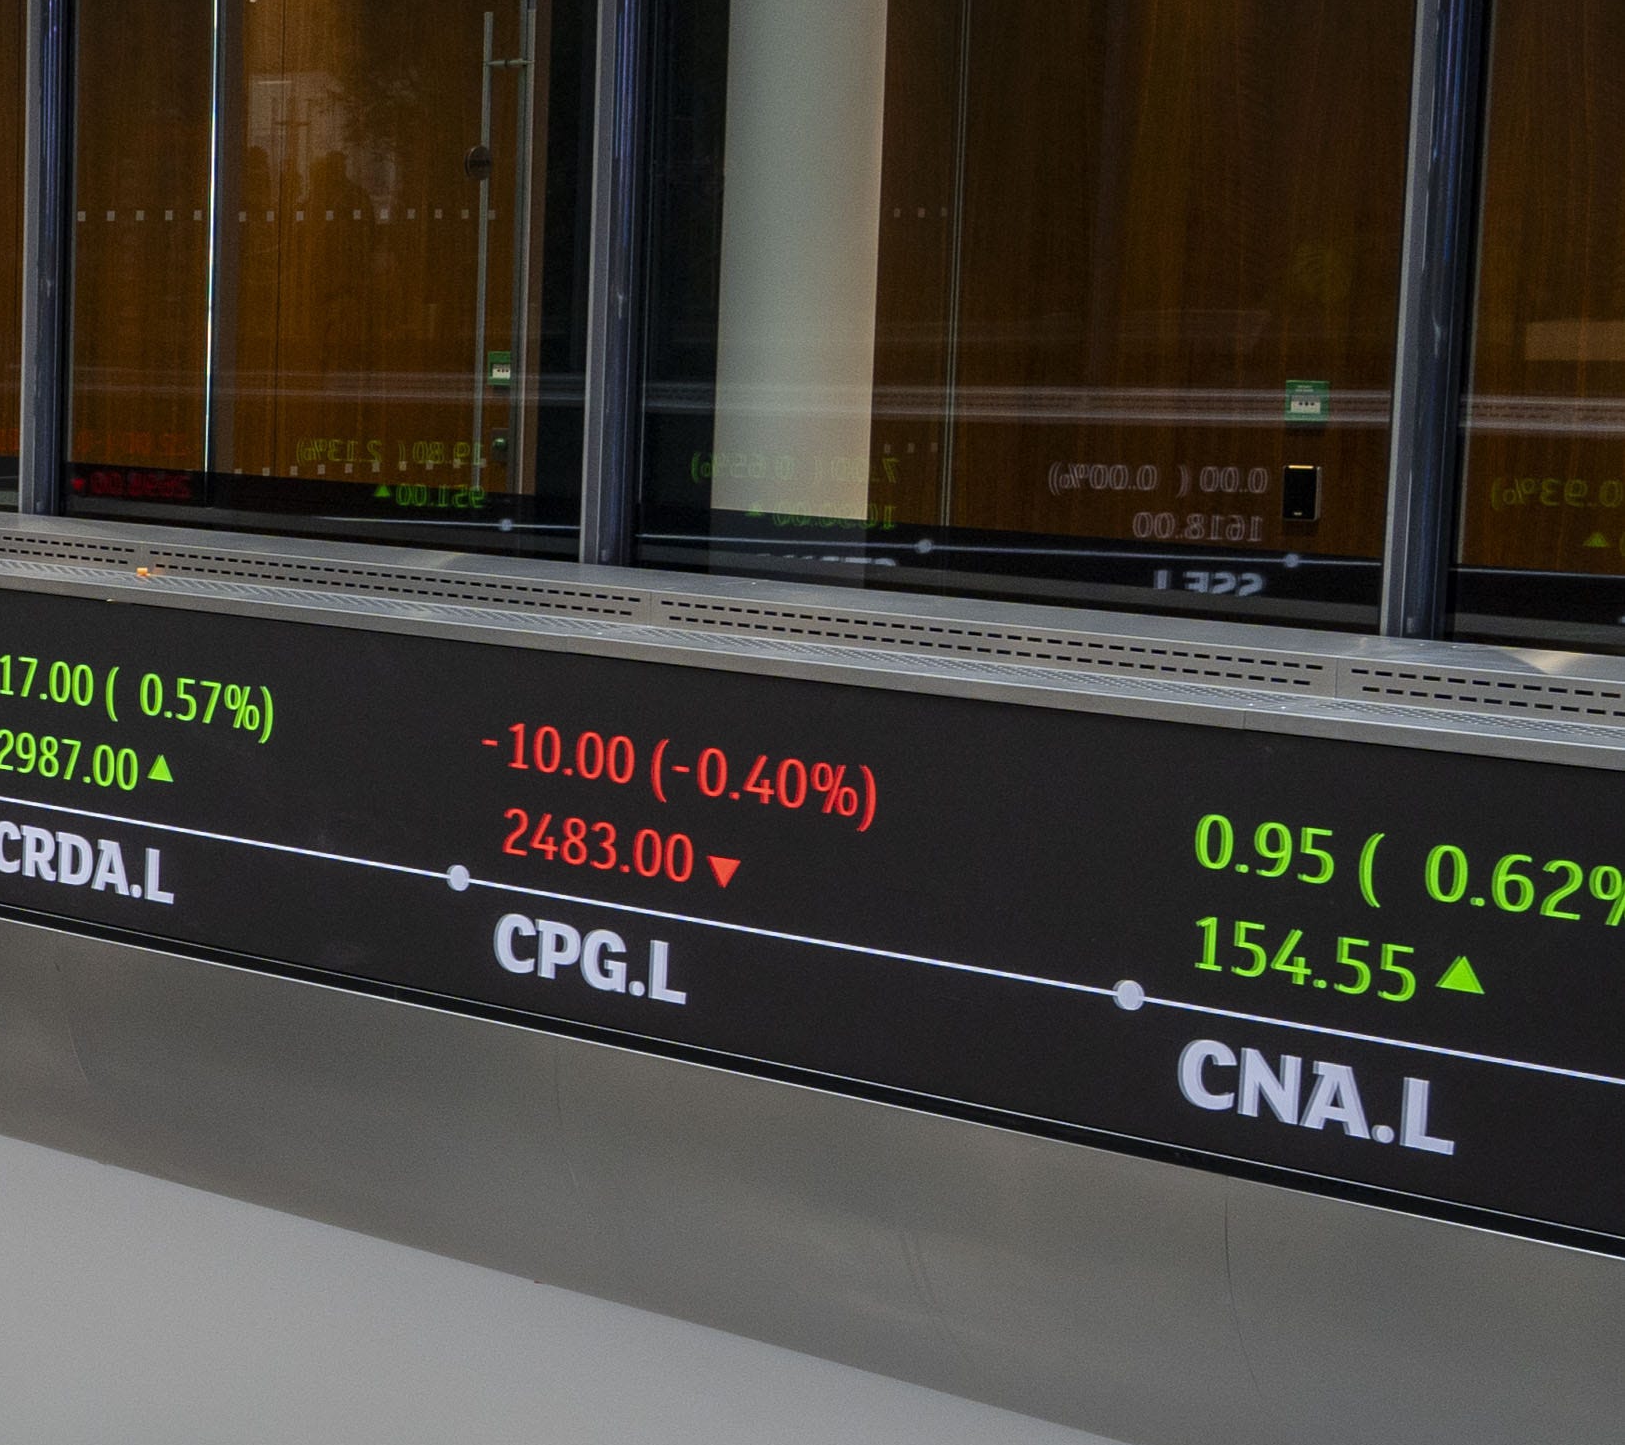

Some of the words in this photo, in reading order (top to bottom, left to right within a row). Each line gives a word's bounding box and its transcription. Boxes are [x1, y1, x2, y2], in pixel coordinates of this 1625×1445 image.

[482, 723, 635, 784] -10.00
[651, 739, 876, 832] (-0.40%)
[503, 808, 693, 882] 2483.00
[494, 914, 686, 1004] CPG.L
[1195, 917, 1416, 1001] 154.55
[1178, 1040, 1454, 1155] CNA.L
